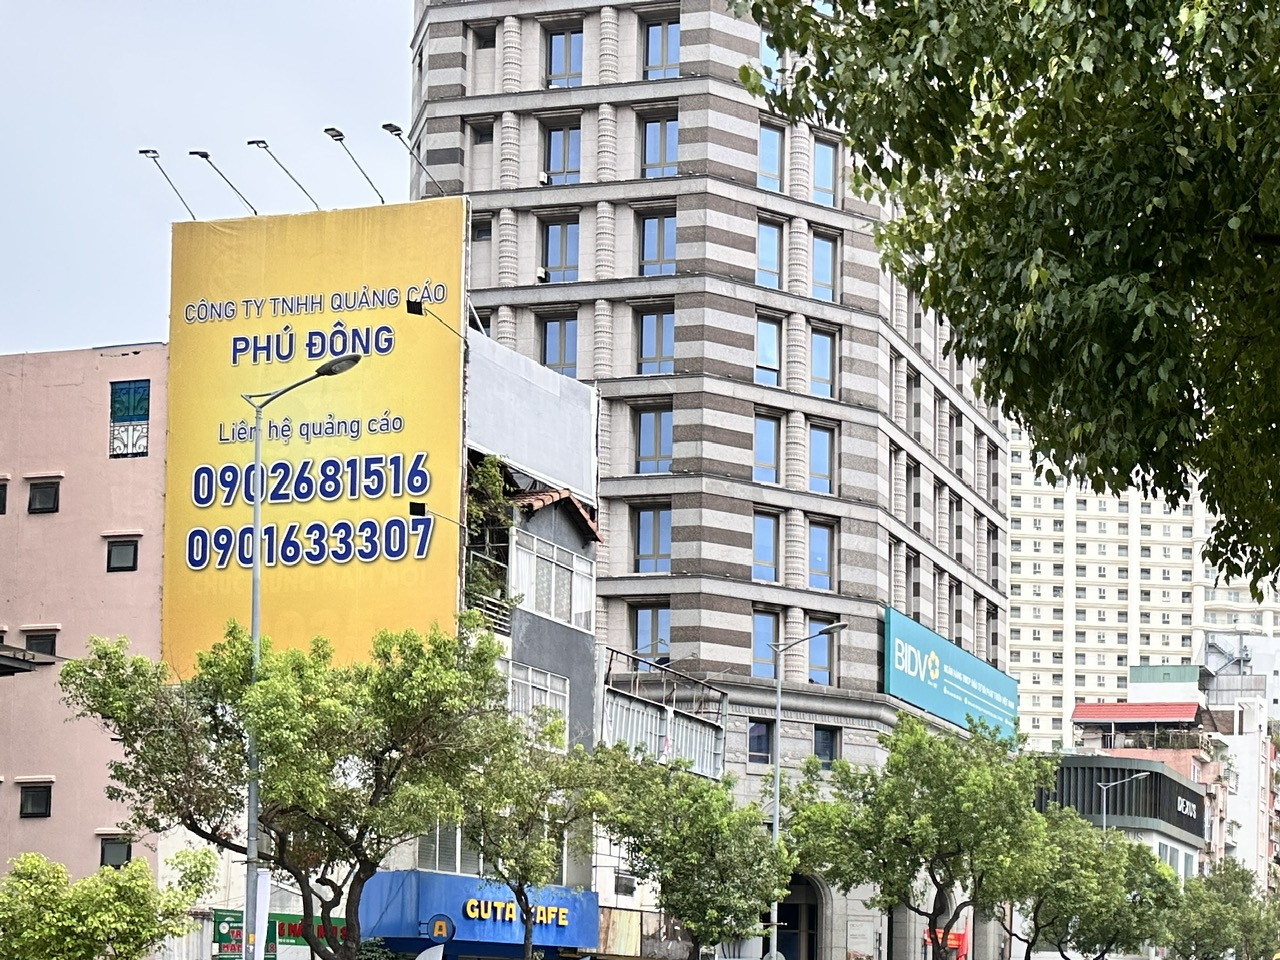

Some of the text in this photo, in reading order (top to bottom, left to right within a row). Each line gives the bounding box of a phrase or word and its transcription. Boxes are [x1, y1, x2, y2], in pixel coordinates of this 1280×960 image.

[185, 278, 448, 323] CÔNG TY TNHH QUẢNG CÁO
[231, 320, 395, 366] PHÚ ĐÔNG
[268, 417, 293, 445] hệ
[299, 412, 361, 441] quảng
[367, 408, 405, 433] cáo
[191, 451, 431, 508] 0902681516
[186, 515, 436, 570] 0901633307
[895, 637, 929, 682] BIDV
[466, 898, 517, 923] GUTA
